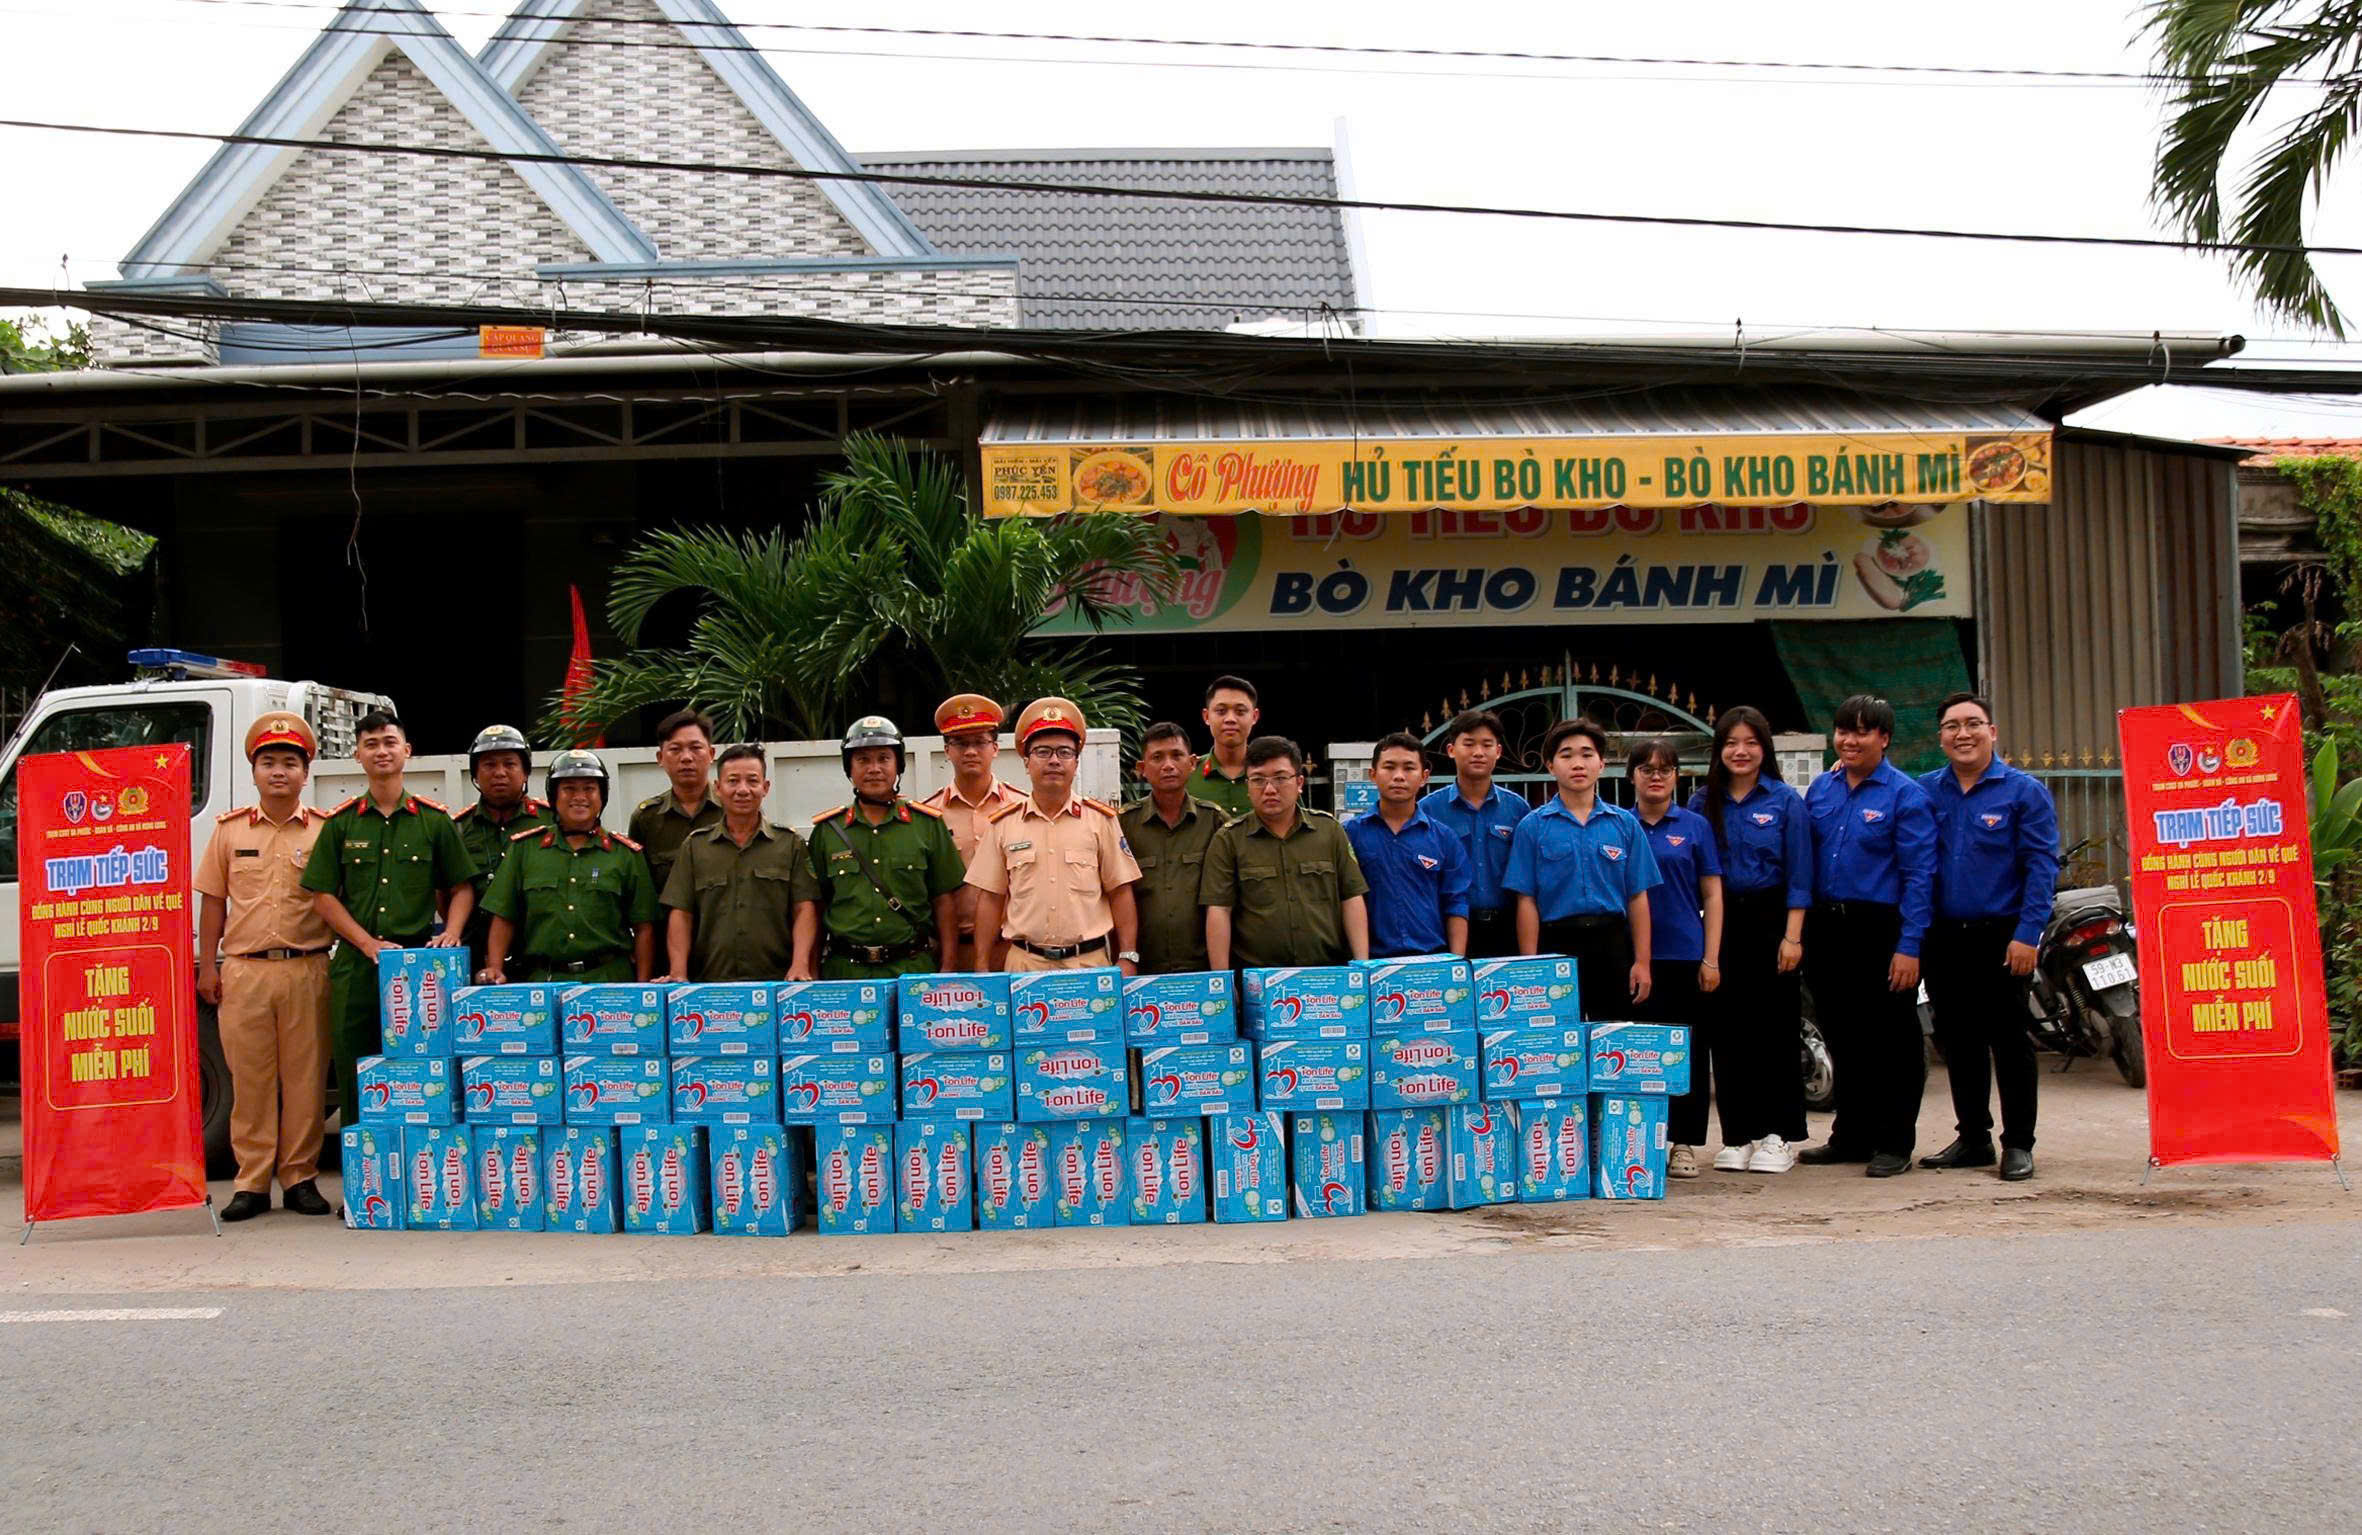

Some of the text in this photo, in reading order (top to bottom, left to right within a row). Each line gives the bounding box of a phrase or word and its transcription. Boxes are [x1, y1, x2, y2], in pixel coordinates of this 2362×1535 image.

[994, 464, 1056, 475] PHÚC YÊN
[1167, 452, 1320, 509] Cô Phượng
[1342, 445, 1962, 501] HỦ TIẾU BÒ KHO - BÒ KHO BÁNH MÌ
[994, 485, 1056, 500] 0987.225.453
[1269, 552, 1842, 615] BÒ KHO BÁNH MÌ
[1358, 790, 1368, 801] 2
[2154, 798, 2282, 848] TRẠM TIẾP SỨC
[46, 845, 167, 895] TRẠM TIẾP SỨC
[2202, 916, 2249, 957] TẶNG
[85, 963, 129, 1004] TẶNG
[2182, 950, 2277, 992] NƯỚC SUỐI
[423, 972, 436, 999] Life
[923, 992, 950, 1006] Life
[64, 998, 155, 1041] NƯỚC SUỐI
[394, 1007, 408, 1035] Life
[2192, 994, 2273, 1032] MIỄN PHÍ
[959, 1023, 986, 1037] Life
[72, 1043, 150, 1082] MIỄN PHÍ
[1040, 1061, 1068, 1075] Life
[1394, 1048, 1420, 1063] Life
[1077, 1091, 1105, 1105] Life
[1429, 1079, 1456, 1092] Life
[1420, 1127, 1432, 1153] Life
[1562, 1117, 1574, 1144] Life
[449, 1149, 461, 1176] Life
[515, 1147, 528, 1174] Life
[580, 1149, 595, 1176] Life
[664, 1150, 677, 1178] Life
[754, 1150, 768, 1177] Life
[864, 1147, 877, 1175] Life
[942, 1145, 955, 1173] Life
[1024, 1142, 1037, 1170] Life
[1097, 1141, 1111, 1169] Life
[1174, 1140, 1187, 1167] Life
[1533, 1152, 1548, 1180] Life
[1144, 1175, 1160, 1203] Life
[1392, 1163, 1407, 1190] Life
[419, 1181, 433, 1210] Life
[488, 1178, 503, 1208] Life
[556, 1180, 572, 1210] Life
[637, 1182, 652, 1212] Life
[727, 1184, 743, 1213] Life
[834, 1181, 848, 1210] Life
[912, 1180, 928, 1208] Life
[994, 1178, 1009, 1206] Life
[1069, 1177, 1084, 1206] Life
